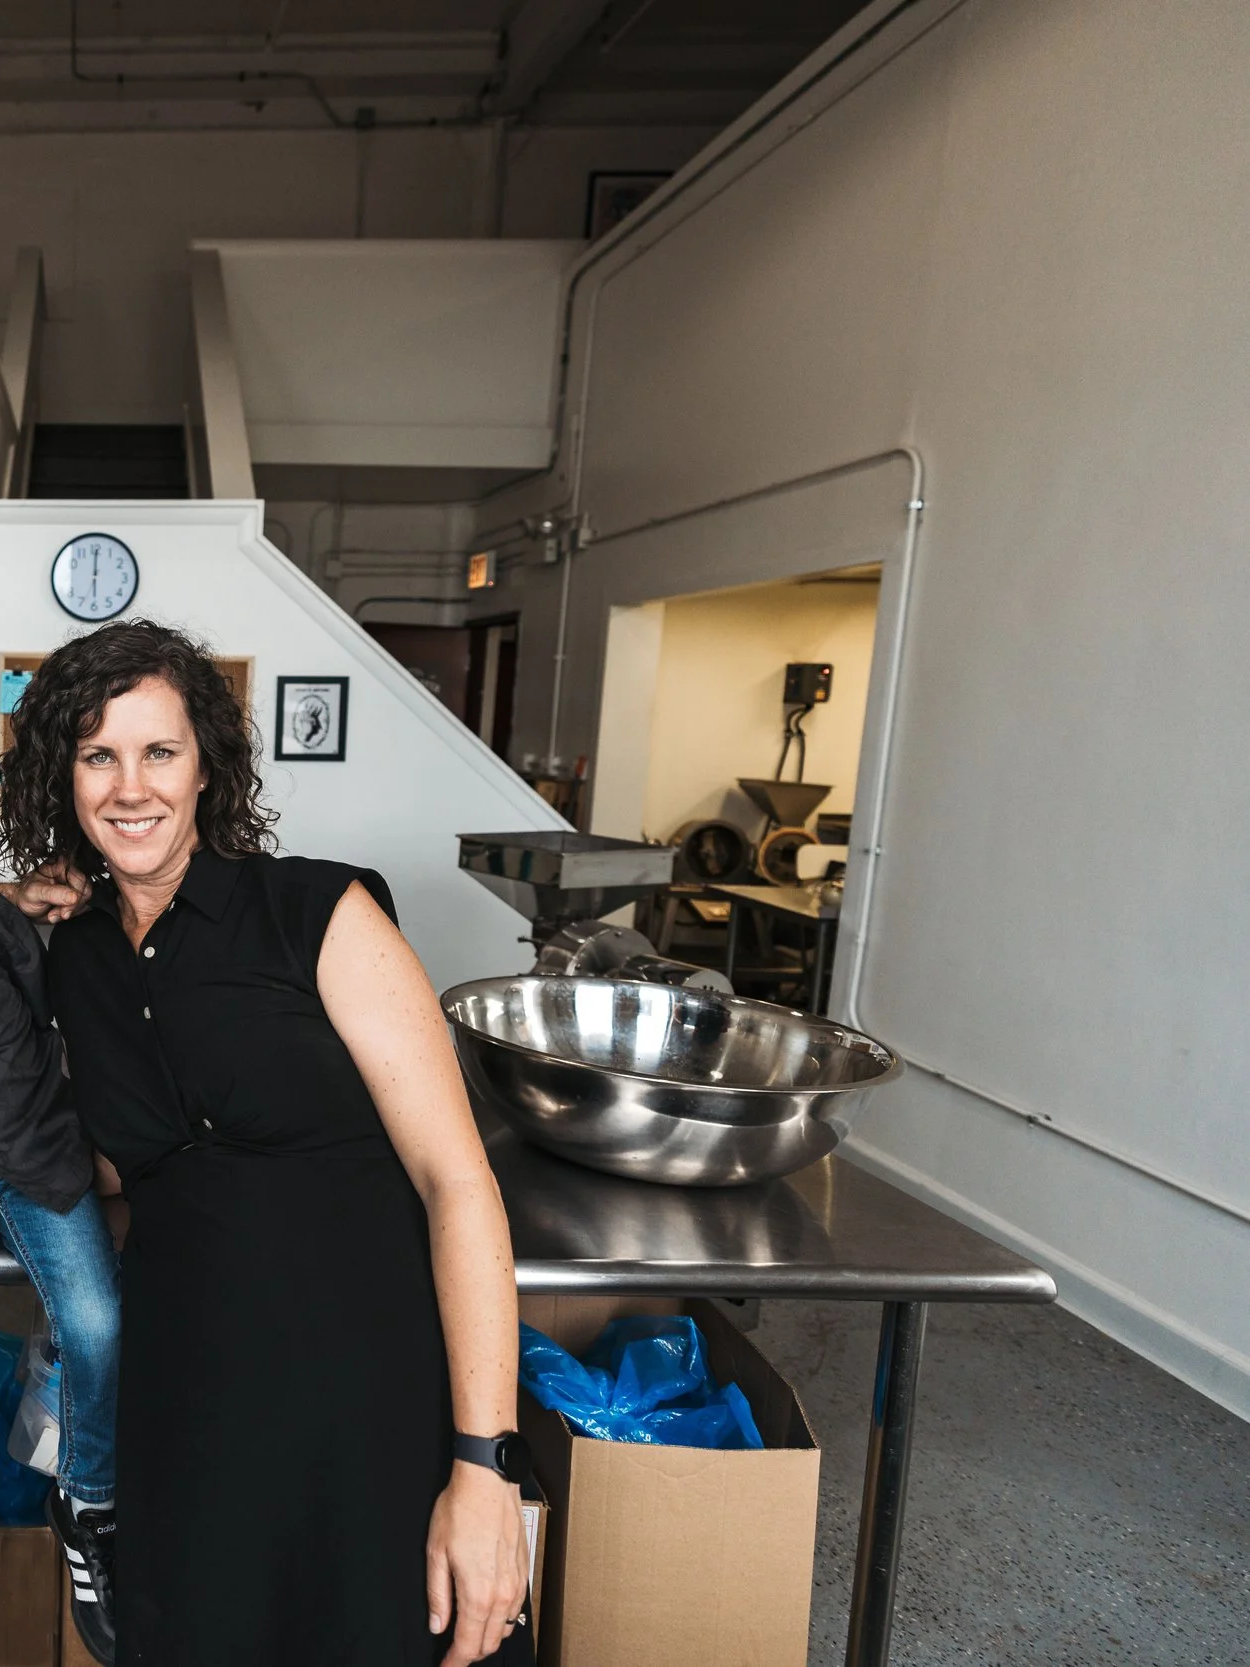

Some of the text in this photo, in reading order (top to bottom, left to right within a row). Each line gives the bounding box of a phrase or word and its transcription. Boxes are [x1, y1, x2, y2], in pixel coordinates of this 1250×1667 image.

[77, 548, 86, 558] 11
[90, 544, 101, 555] 12
[108, 548, 112, 558] 1
[116, 557, 124, 569] 2
[121, 572, 128, 584] 3
[116, 587, 123, 597] 4
[78, 596, 85, 607] 7
[90, 601, 98, 611] 6
[105, 596, 113, 608] 5
[97, 1522, 116, 1534] adid
